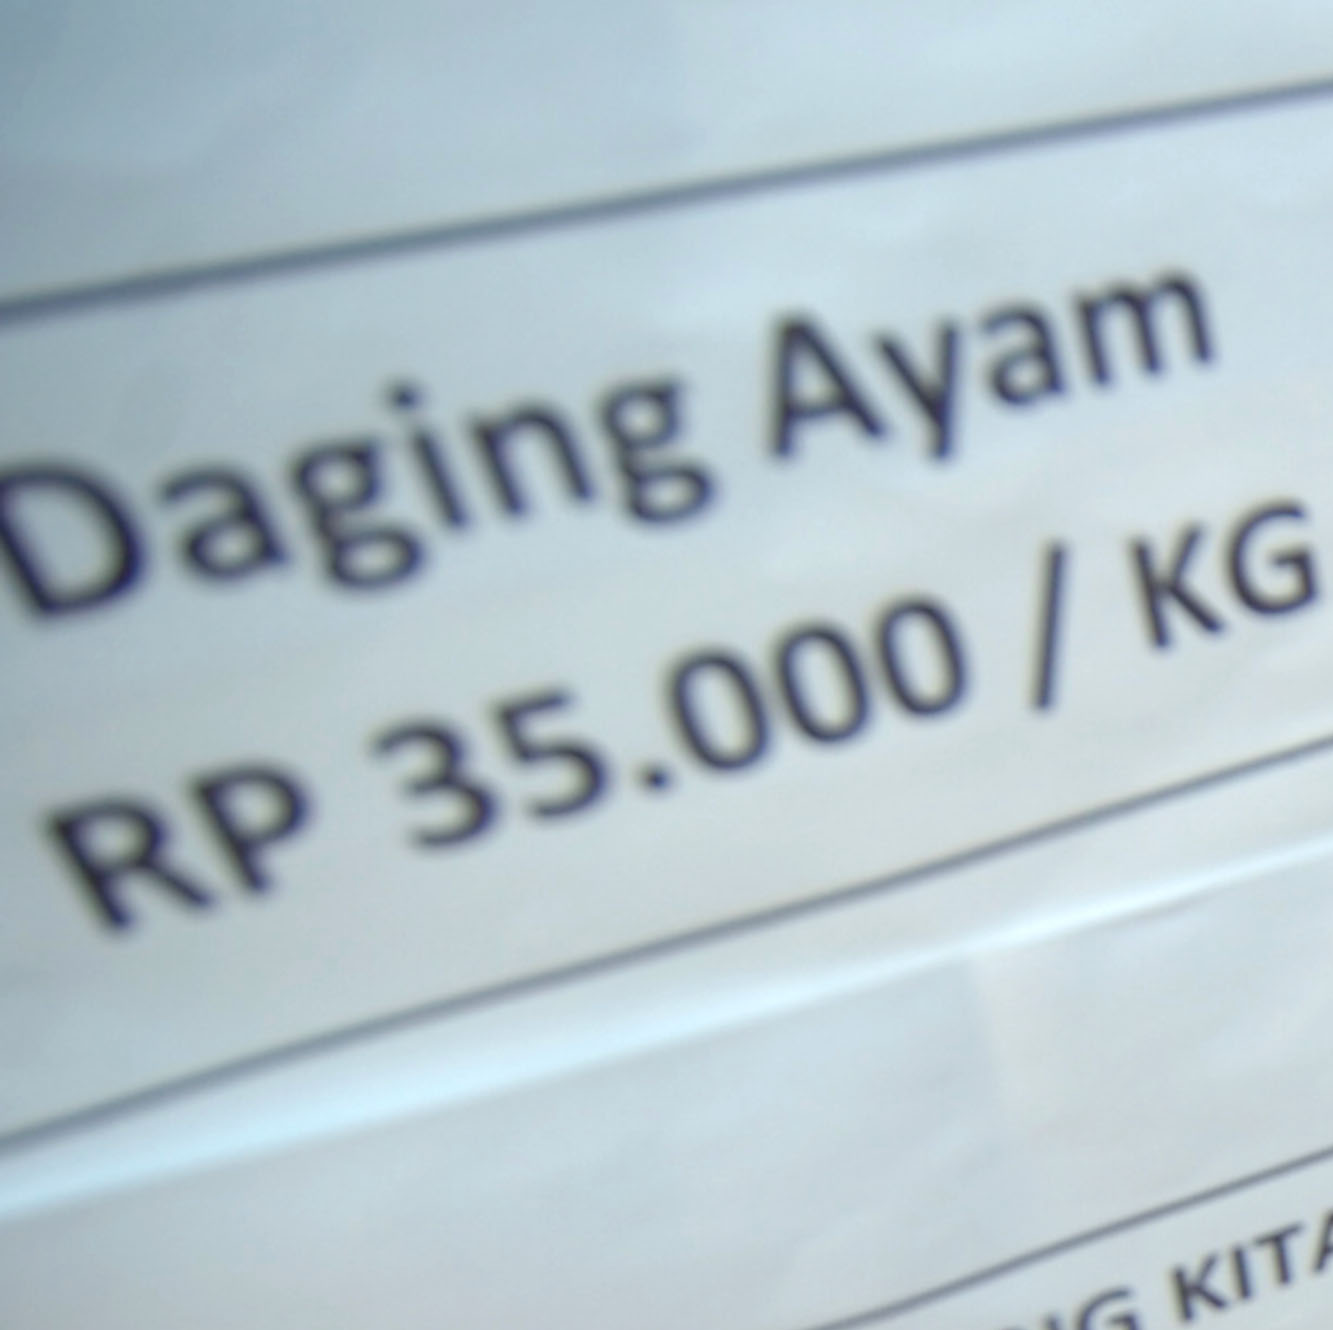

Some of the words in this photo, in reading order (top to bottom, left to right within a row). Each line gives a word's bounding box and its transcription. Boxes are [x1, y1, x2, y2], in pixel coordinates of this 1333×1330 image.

[0, 379, 716, 626] Daging
[767, 271, 1216, 464] Ayam
[43, 764, 311, 934] RP
[372, 595, 971, 852] 35.000
[1029, 539, 1071, 715] /
[1128, 499, 1322, 652] KG
